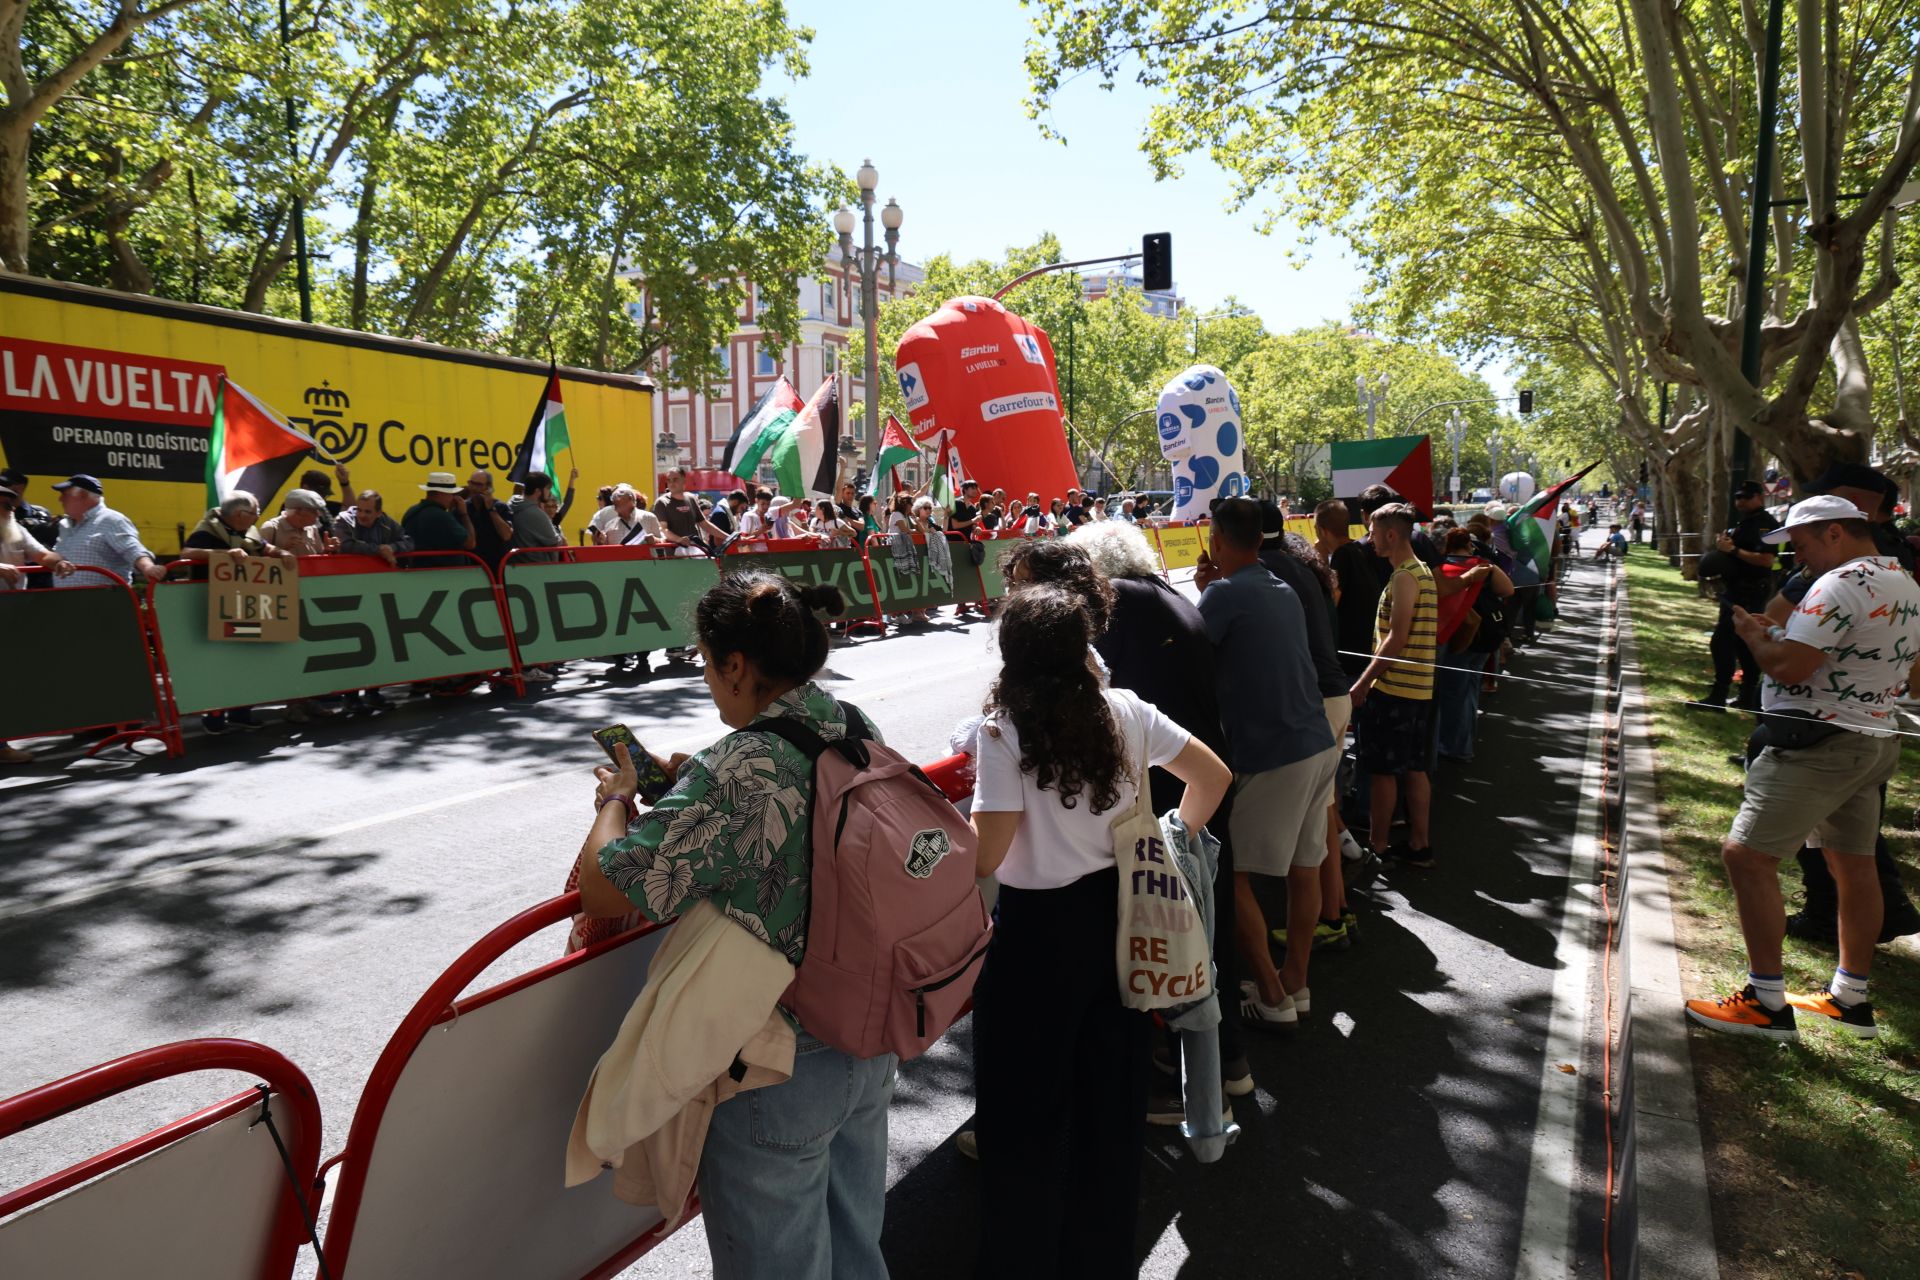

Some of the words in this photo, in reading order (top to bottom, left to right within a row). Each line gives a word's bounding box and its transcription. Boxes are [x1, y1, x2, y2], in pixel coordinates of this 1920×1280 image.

[961, 344, 999, 359] Santini
[976, 359, 999, 372] VUELTA
[3, 350, 60, 400] LA
[64, 357, 216, 416] VUELTA
[989, 396, 1044, 415] Carrefour
[52, 426, 134, 447] OPERADOR
[138, 431, 209, 453] LOGÍSTICO
[1163, 439, 1186, 452] Santini
[107, 451, 165, 470] OFICIAL
[214, 562, 283, 585] GAZA
[1135, 836, 1165, 865] RE
[1129, 902, 1193, 934] AND
[1129, 936, 1169, 965] RE
[1128, 961, 1205, 998] CYCLE
